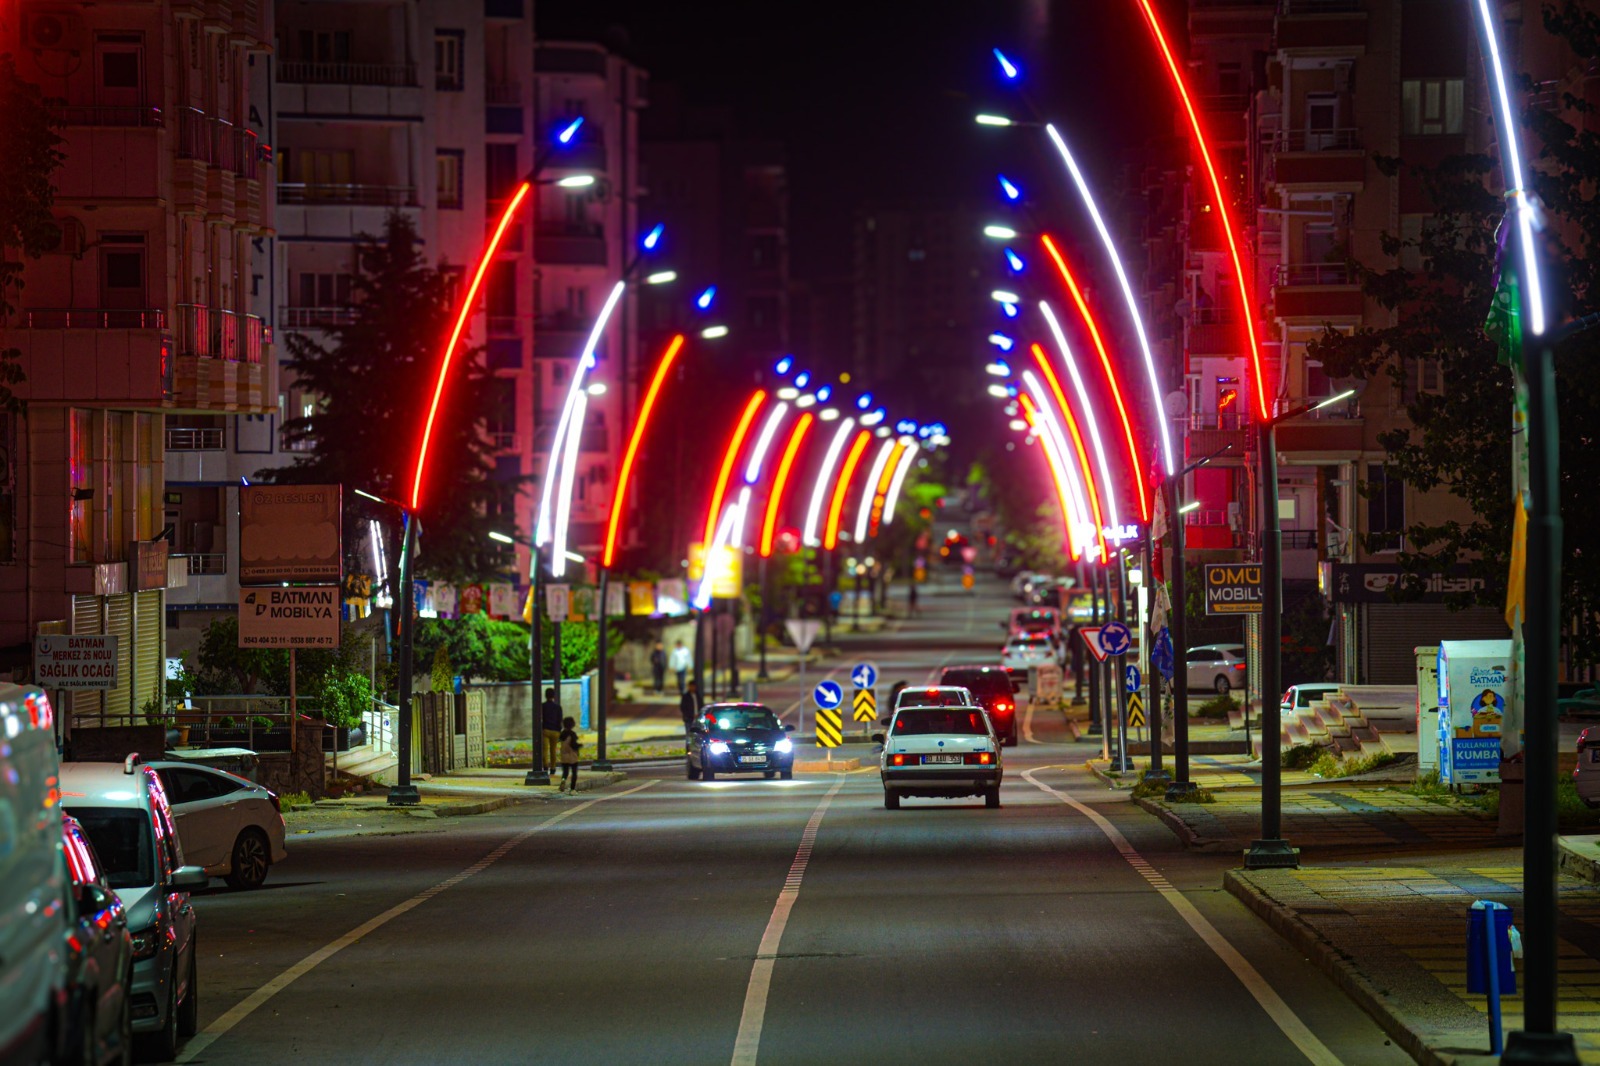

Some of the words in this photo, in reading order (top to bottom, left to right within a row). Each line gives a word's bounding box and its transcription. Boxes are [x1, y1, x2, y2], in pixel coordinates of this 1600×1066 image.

[1209, 567, 1260, 585] ÖMÜ
[271, 591, 332, 604] BATMAN
[68, 638, 105, 649] BATMAN
[279, 636, 286, 644] 11
[52, 650, 81, 661] MERKEZ
[83, 650, 91, 660] 26
[93, 650, 112, 660] NOLU
[40, 662, 79, 678] SAĞLIK
[81, 662, 115, 678] OCAĞI
[1470, 675, 1505, 684] BATMAN
[1456, 741, 1500, 749] KULLANILMI
[1456, 750, 1500, 760] KUMBA
